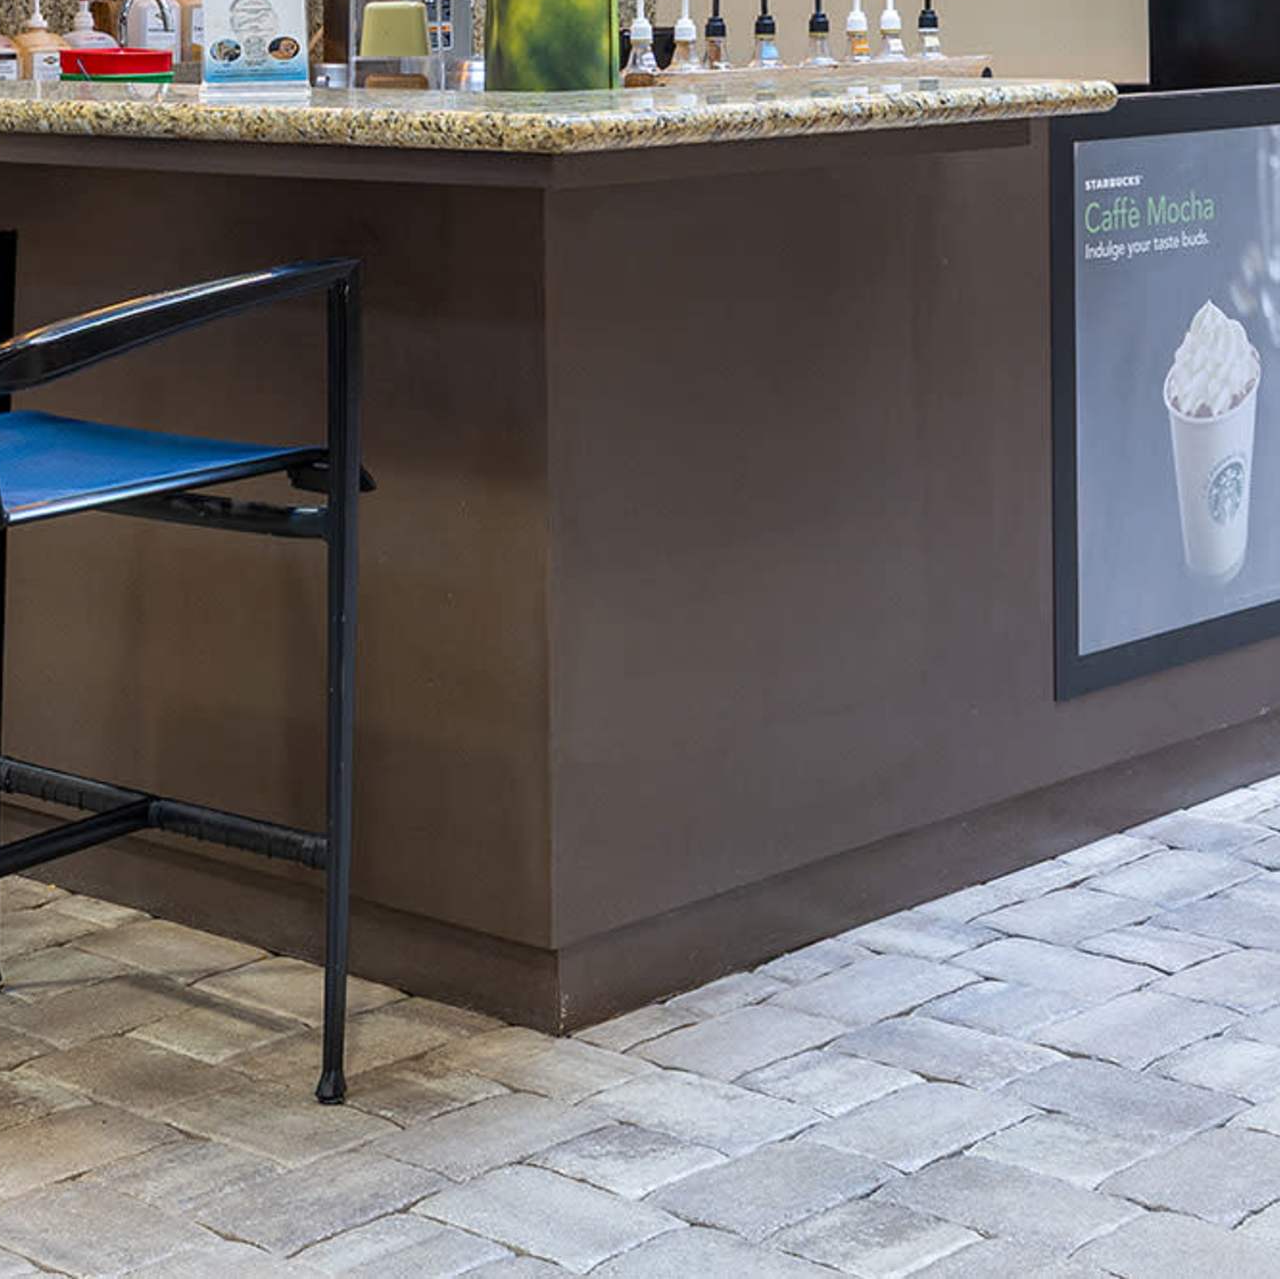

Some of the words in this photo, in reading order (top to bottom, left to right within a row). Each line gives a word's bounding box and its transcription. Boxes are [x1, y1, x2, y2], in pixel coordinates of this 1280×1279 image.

[1084, 175, 1142, 191] STARBUCKS
[1084, 196, 1141, 233] Caffè
[1147, 190, 1215, 226] Mocha
[1085, 240, 1125, 261] Indulge
[1127, 239, 1152, 259] your
[1153, 236, 1180, 251] taste
